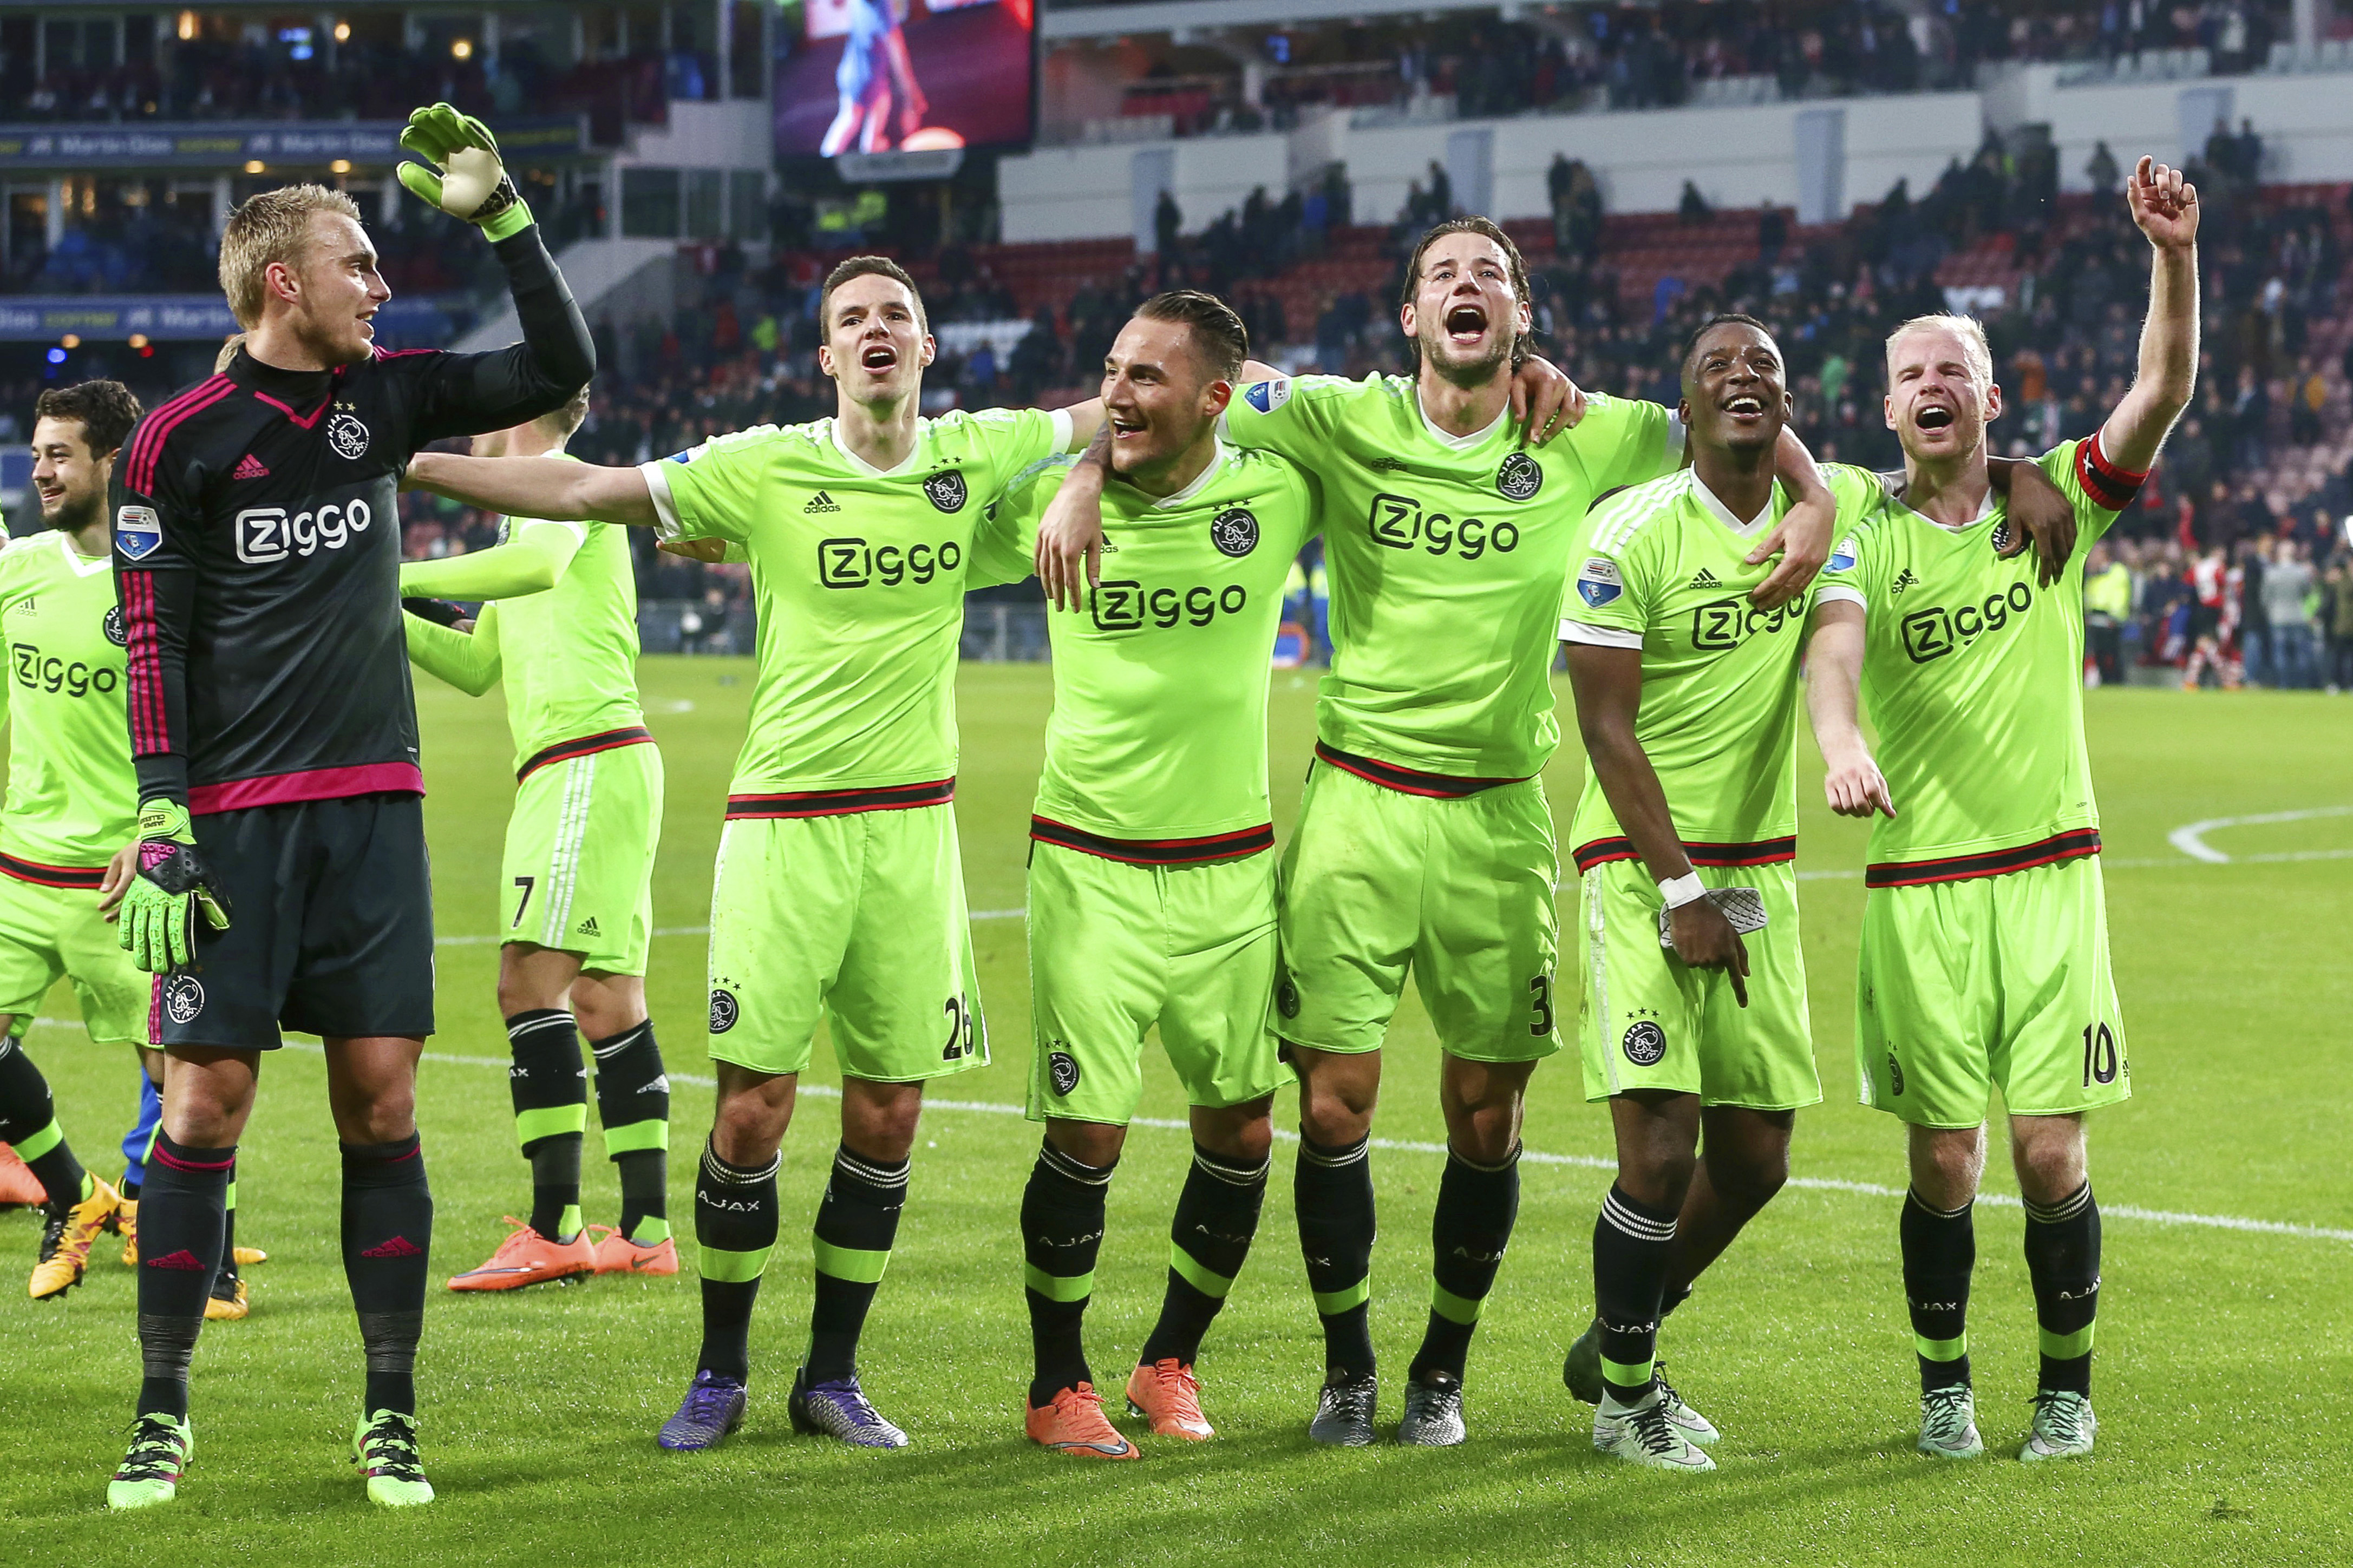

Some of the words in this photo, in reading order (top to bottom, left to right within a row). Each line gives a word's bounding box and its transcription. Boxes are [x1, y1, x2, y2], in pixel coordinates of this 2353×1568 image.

[1499, 456, 1518, 477] AJAX
[804, 504, 841, 514] adidas
[1213, 511, 1233, 532] AJAX
[1689, 580, 1723, 590] adidas
[512, 876, 535, 928] 7
[165, 974, 183, 1000] AJAX
[1528, 974, 1553, 1037] 3
[943, 990, 973, 1061] 26
[1624, 1023, 1644, 1044] AJAX
[2082, 1021, 2117, 1087] 10
[698, 1190, 760, 1212] AJAX
[1598, 1316, 1655, 1334] AJAX
